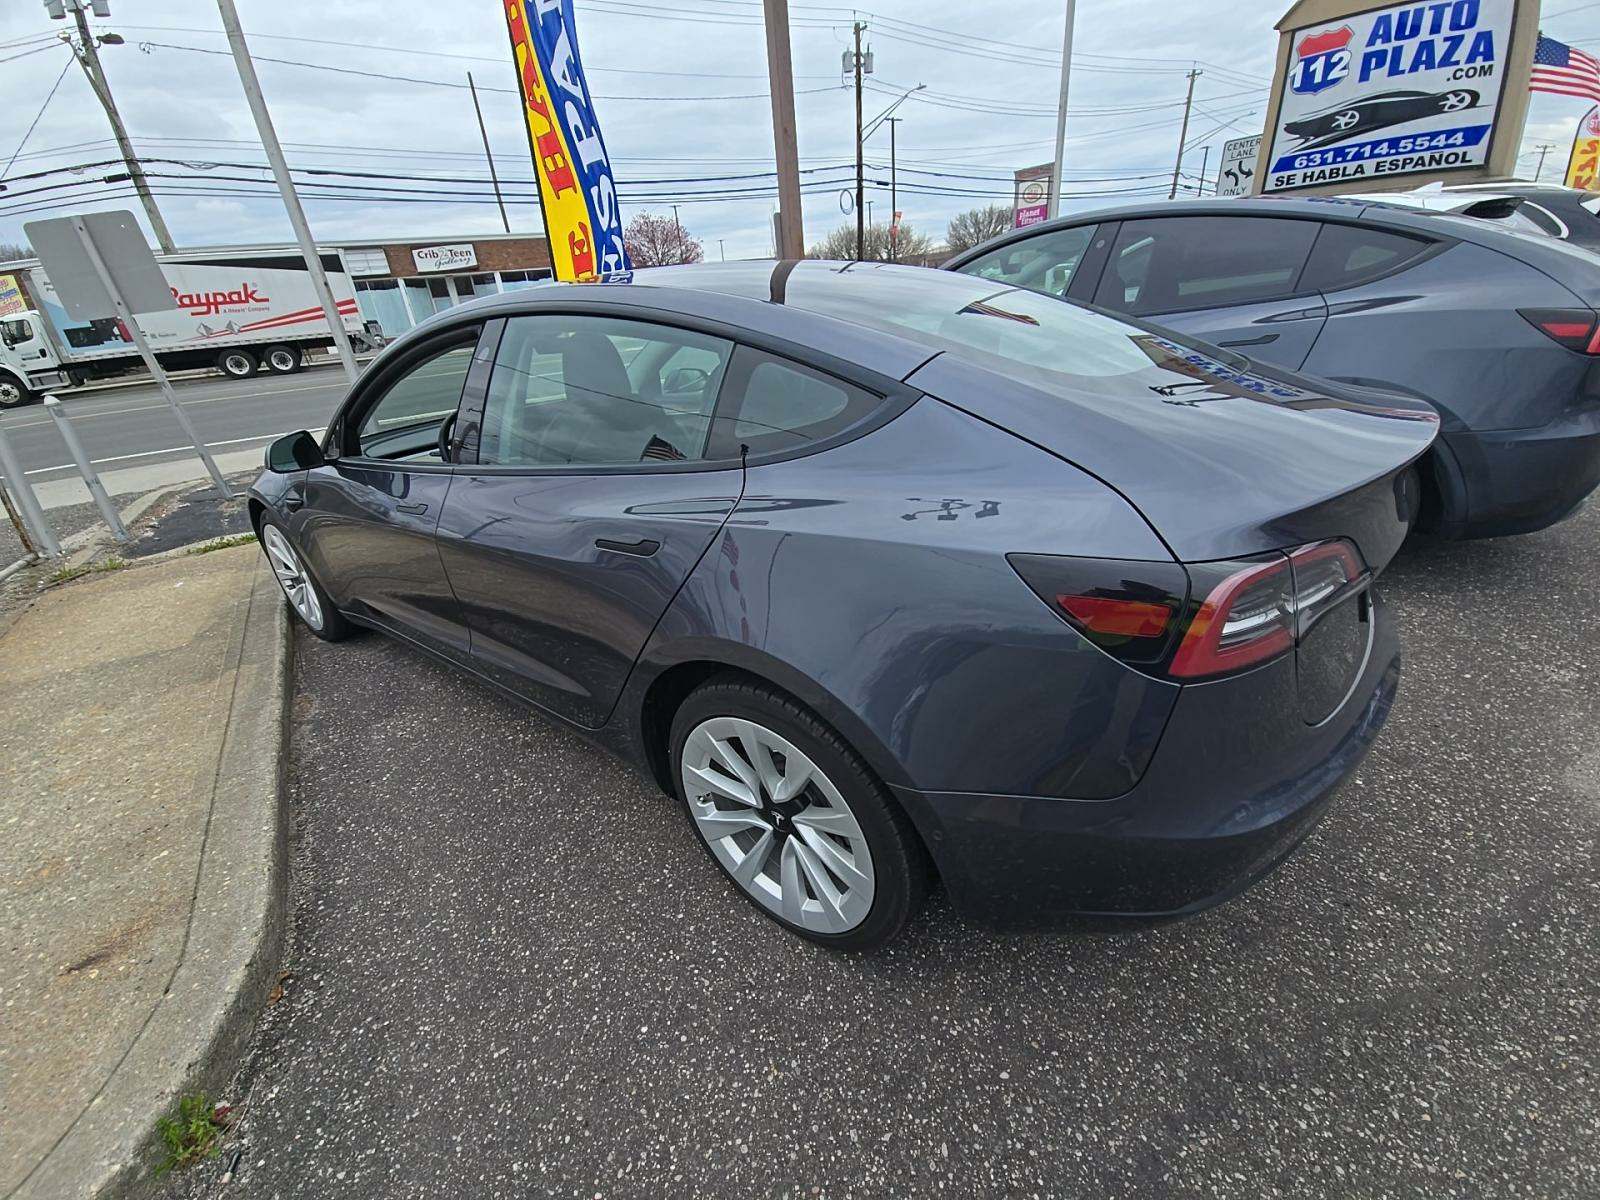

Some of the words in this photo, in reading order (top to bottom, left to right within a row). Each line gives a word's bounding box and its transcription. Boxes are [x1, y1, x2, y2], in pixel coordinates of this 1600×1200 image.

[1365, 0, 1480, 48] AUTO
[1289, 50, 1351, 89] 112
[1358, 30, 1495, 83] PLAZA
[1446, 64, 1493, 81] .COM
[1227, 137, 1262, 151] CENTER
[1231, 148, 1255, 159] LANE
[1294, 132, 1464, 168] 631.714.5544
[1275, 173, 1297, 187] SE
[1302, 163, 1365, 183] HABLA
[1374, 150, 1473, 174] ESPAÑOL
[1223, 187, 1246, 196] ONLY
[417, 249, 439, 259] Crib
[448, 249, 472, 258] Teen
